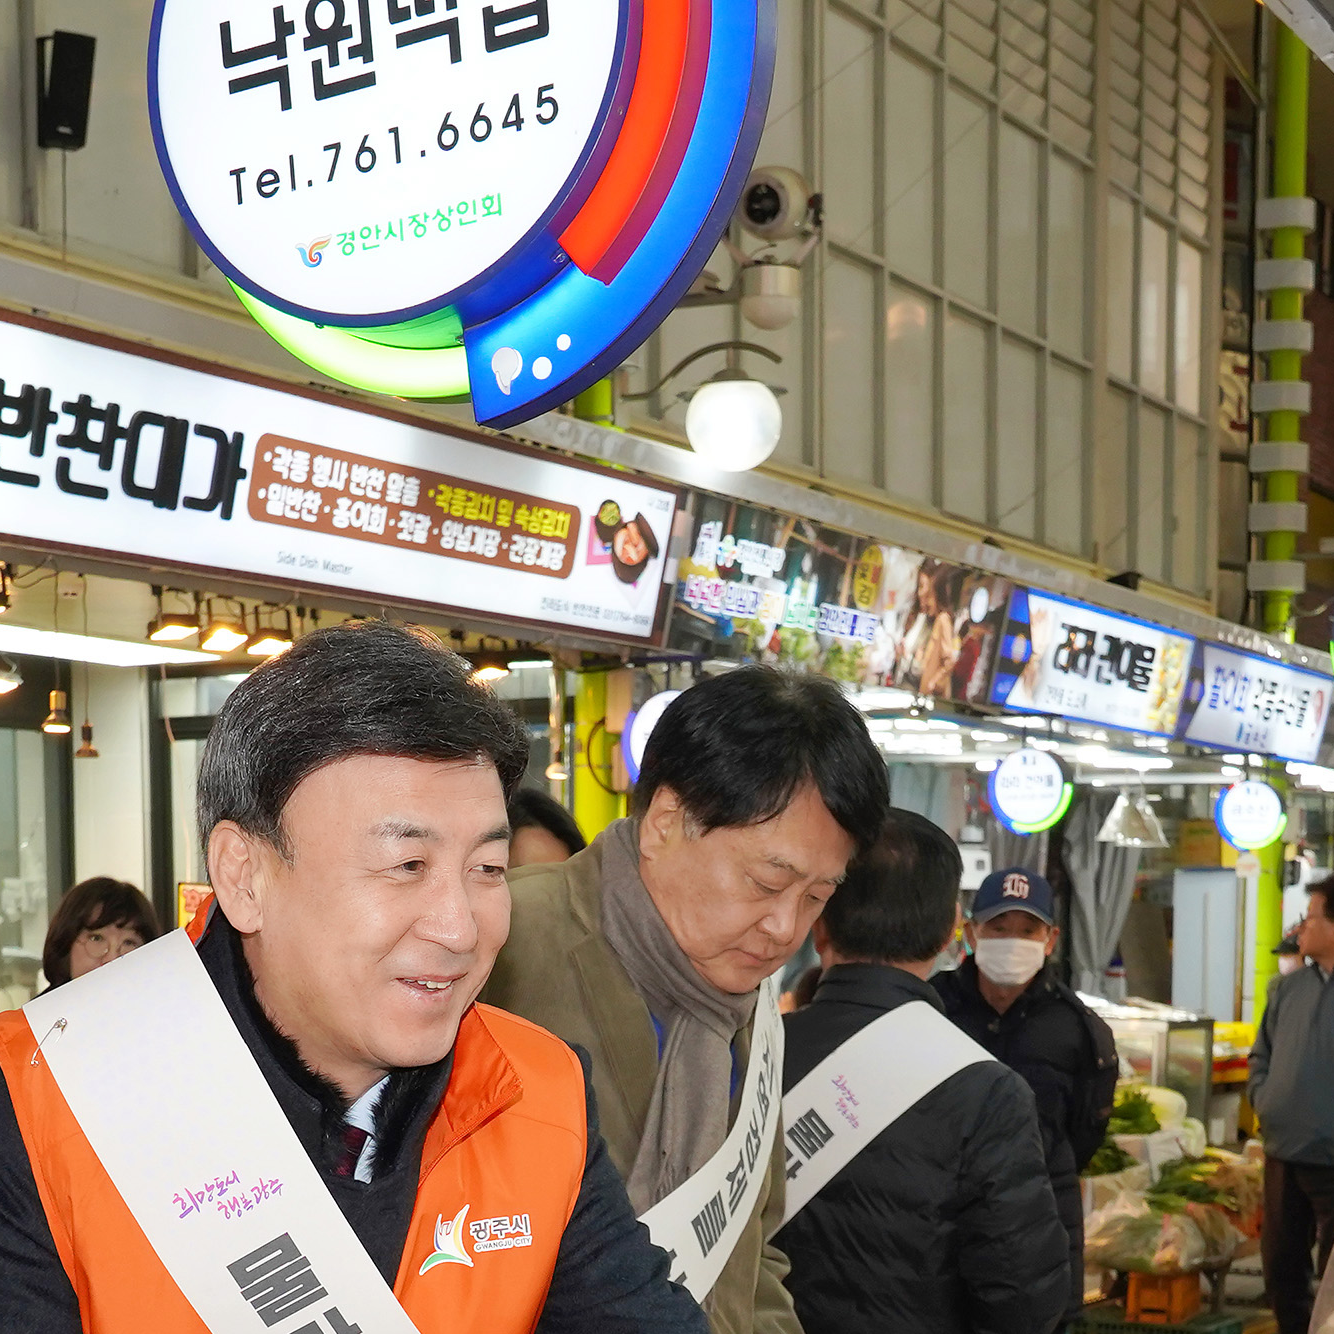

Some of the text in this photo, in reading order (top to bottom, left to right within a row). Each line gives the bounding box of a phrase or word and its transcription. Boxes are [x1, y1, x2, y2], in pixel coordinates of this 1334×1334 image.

[229, 83, 560, 206] Tel.761.6645
[335, 192, 504, 258] 경안시장상인회
[349, 463, 386, 500] 반찬
[171, 1169, 241, 1219] 희망도시
[216, 1177, 284, 1220] 행복광주
[471, 1215, 529, 1241] 광주시
[474, 1237, 532, 1251] GWANGJU CITY
